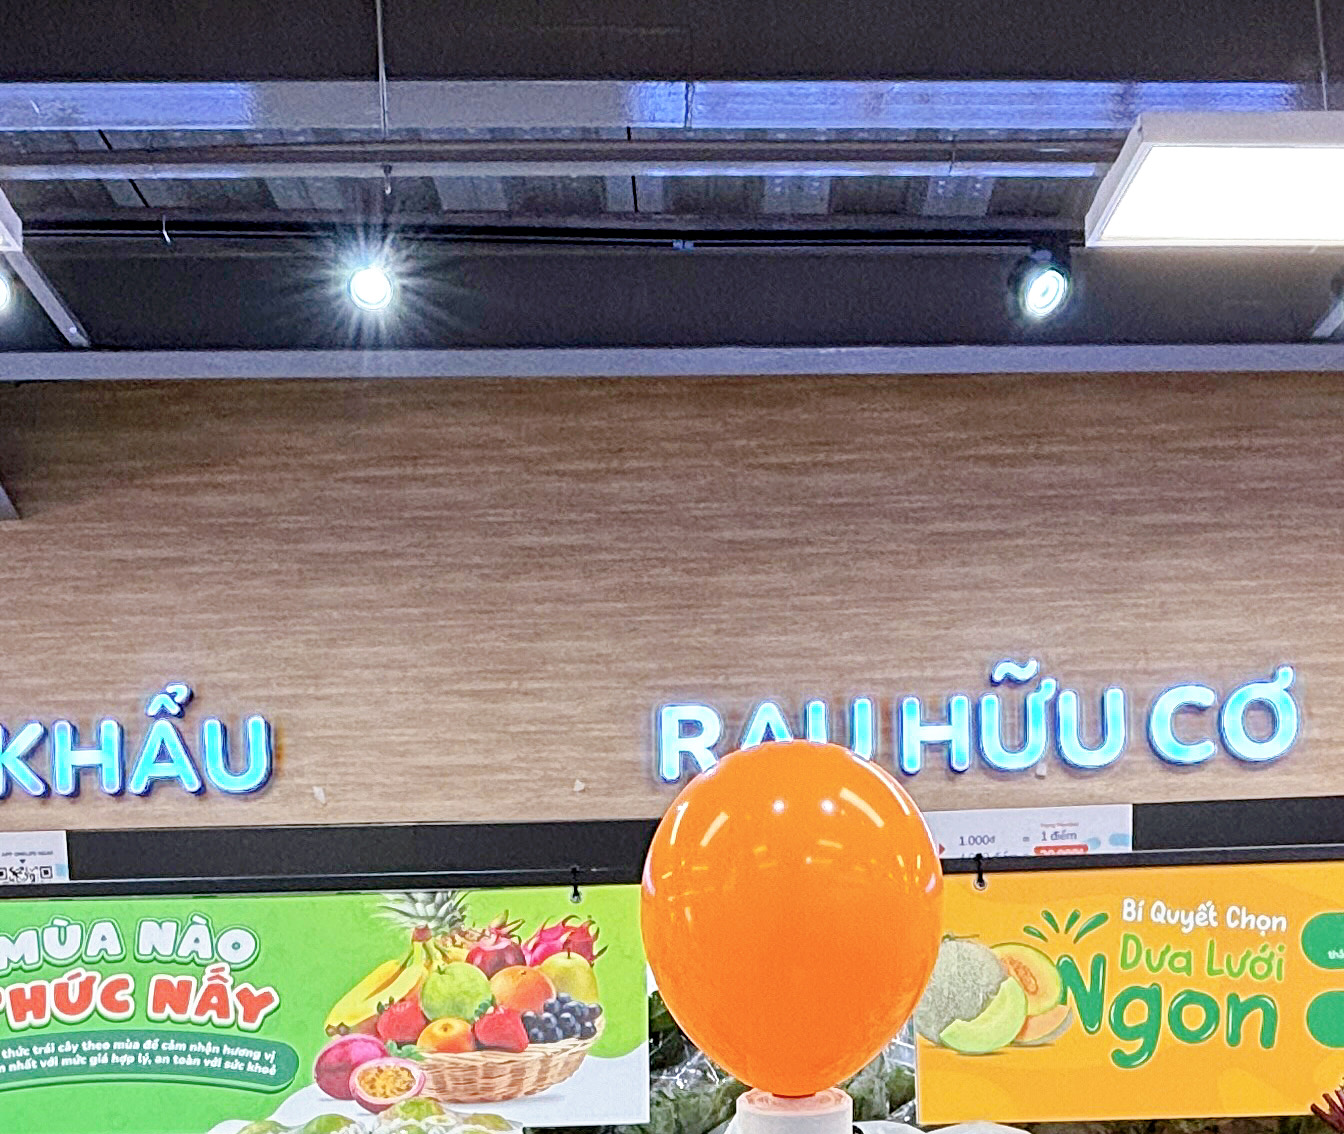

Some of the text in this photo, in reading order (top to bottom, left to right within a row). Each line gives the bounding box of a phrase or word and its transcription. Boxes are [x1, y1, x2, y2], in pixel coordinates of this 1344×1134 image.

[657, 658, 1302, 782] RAU HỮU CƠ
[136, 913, 259, 964] NÀO
[1122, 897, 1287, 936] Bí Quyết Chọn
[1120, 933, 1286, 982] Dưa Lưới
[148, 966, 279, 1032] NẤY
[1056, 953, 1279, 1069] Ngon
[2, 1046, 30, 1058] thức
[32, 1042, 55, 1054] trái
[58, 1040, 79, 1053] cây
[82, 1040, 111, 1051] theo
[113, 1038, 140, 1050] mùa
[143, 1039, 159, 1050] để
[161, 1039, 187, 1051] cảm
[189, 1041, 220, 1055] nhận
[223, 1044, 261, 1060] hương
[264, 1050, 276, 1064] vị
[8, 1057, 37, 1071] nhất
[40, 1056, 58, 1068] với
[61, 1053, 86, 1066] mức
[89, 1053, 108, 1066] giá
[111, 1053, 135, 1066] hợp
[138, 1052, 152, 1065] lý,
[154, 1054, 170, 1064] an
[173, 1053, 201, 1066] toàn
[203, 1057, 221, 1068] với
[224, 1058, 244, 1071] sức
